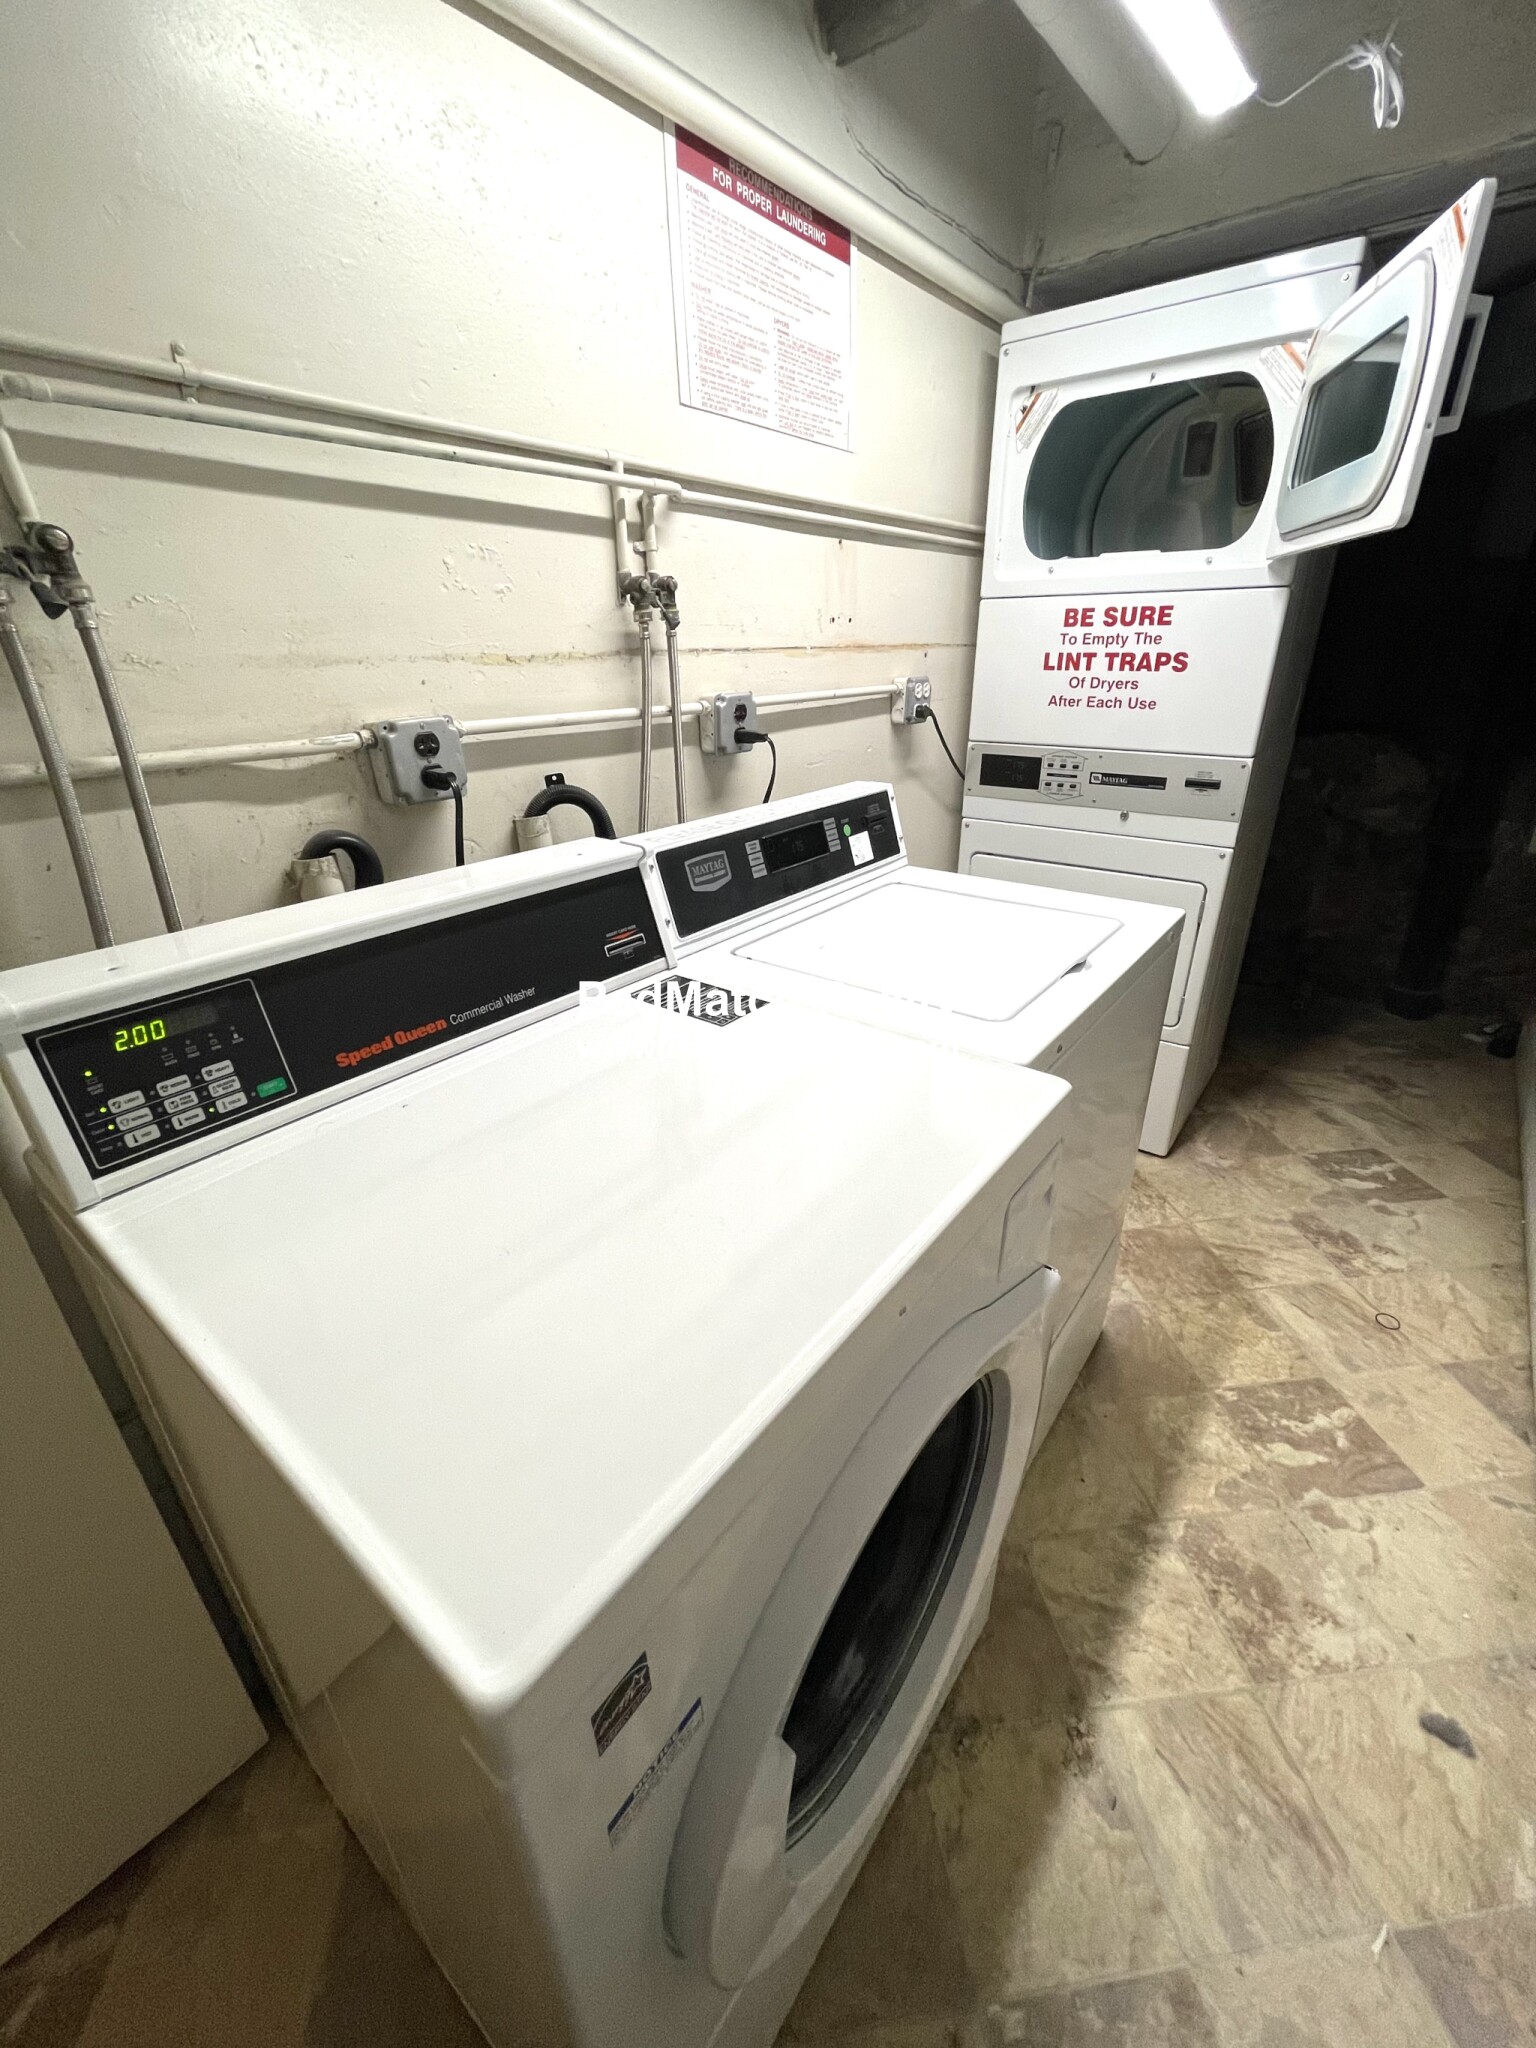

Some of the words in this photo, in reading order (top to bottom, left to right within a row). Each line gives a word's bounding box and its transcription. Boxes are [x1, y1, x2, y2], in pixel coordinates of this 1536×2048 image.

[728, 158, 813, 221] RECOMMENDATIONS
[712, 166, 733, 192] FOR
[736, 182, 773, 216] PROPER
[776, 205, 827, 247] LAUNDERING
[1063, 607, 1096, 628] BE
[1102, 605, 1174, 627] SURE
[1060, 633, 1078, 646] To
[1082, 632, 1129, 648] Empty
[1134, 632, 1163, 645] The
[1043, 652, 1098, 671] LINT
[1104, 652, 1189, 672] TRAPS
[1068, 676, 1087, 689] Of
[1090, 677, 1139, 691] Dryers
[1047, 694, 1082, 708] After
[1086, 696, 1123, 708] Each
[1128, 697, 1157, 710] Use
[1102, 776, 1128, 784] MAYTAG
[691, 858, 725, 877] MAYTAG
[114, 1019, 166, 1052] 2.00
[335, 1034, 394, 1069] Speed
[394, 1017, 449, 1046] Queen
[449, 997, 505, 1026] Commercial
[505, 985, 537, 1006] Washer
